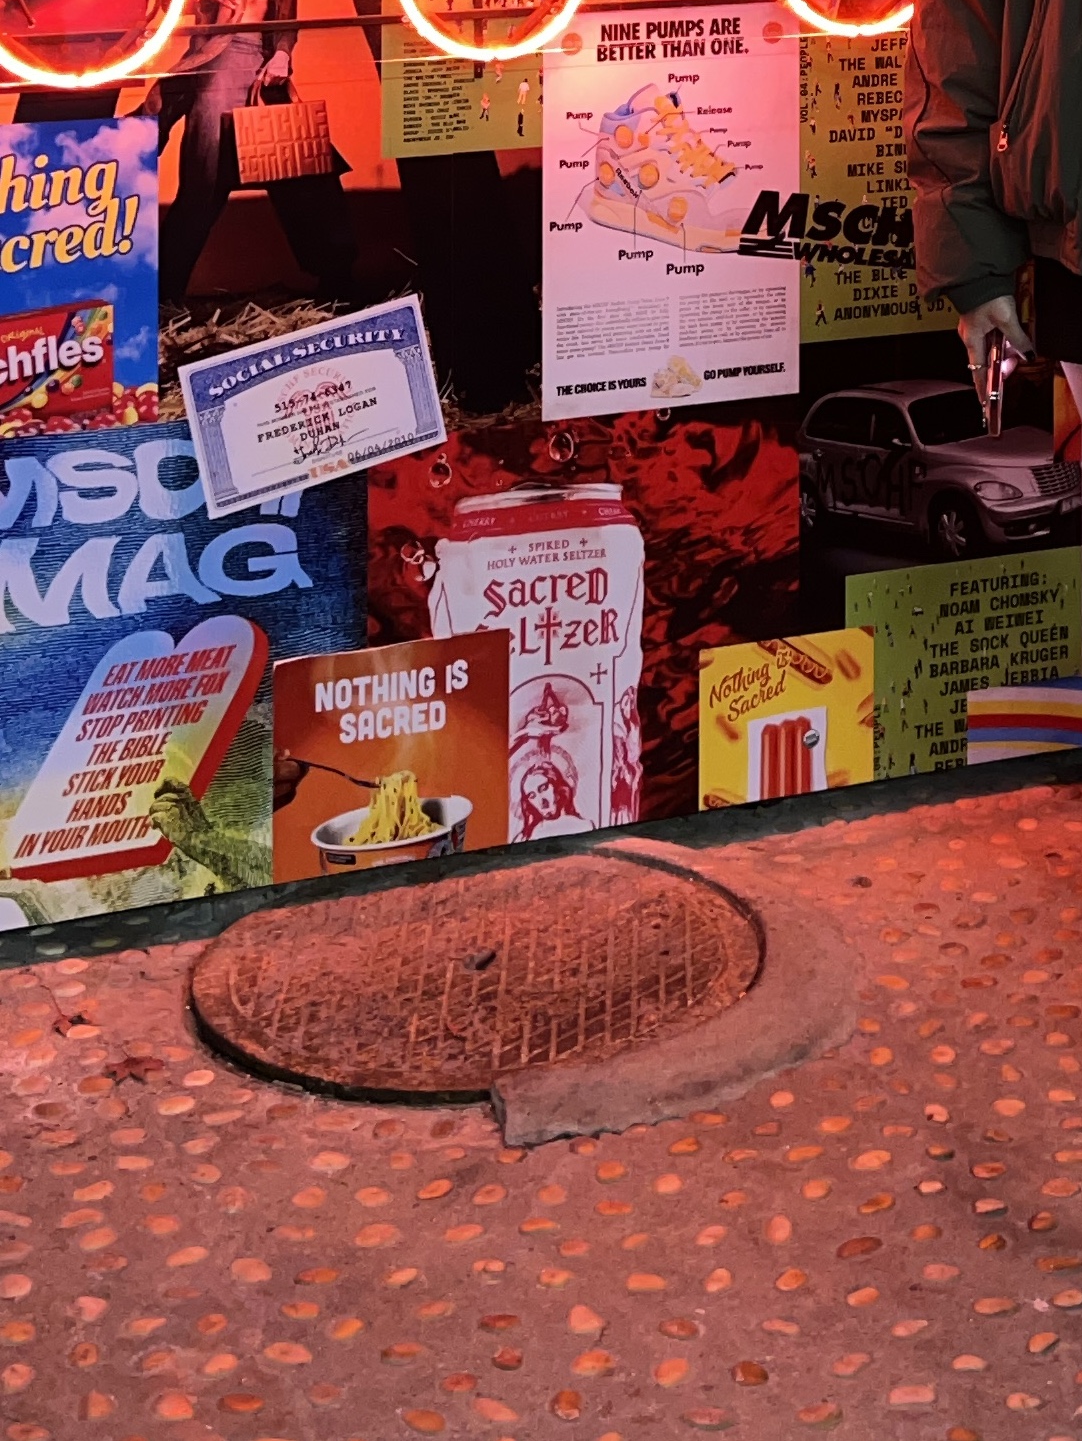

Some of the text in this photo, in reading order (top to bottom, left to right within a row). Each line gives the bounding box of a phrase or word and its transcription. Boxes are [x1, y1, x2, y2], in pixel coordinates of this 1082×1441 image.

[601, 17, 741, 42] NINE PUMPS ARE
[597, 36, 749, 62] BETTER THAN ONE.
[839, 55, 905, 71] THE WAL
[668, 73, 700, 83] Pump
[852, 73, 897, 88] ANDRE
[857, 90, 902, 105] REBEC
[566, 110, 593, 121] Pump
[829, 127, 875, 143] DAVID
[559, 159, 590, 169] Pump
[848, 162, 885, 177] MIKE
[549, 221, 583, 232] Pump
[741, 190, 914, 247] MSCH
[618, 249, 654, 261] Pump
[666, 263, 704, 276] Pump
[834, 270, 862, 285] THE
[853, 285, 898, 301] DIXIE
[208, 328, 405, 398] SOCIAL SECURITY
[703, 369, 717, 380] GO
[717, 366, 741, 378] PUMP
[556, 377, 647, 396] THE CHOICE IS YOURS
[257, 413, 330, 443] FREDERICK
[338, 397, 378, 417] LOGAN
[308, 461, 349, 478] USA
[528, 539, 570, 552] SPIKED
[487, 548, 607, 571] HOLY WATER SELTZER
[950, 572, 1048, 597] FEATURING:
[939, 599, 980, 618] NOAM
[955, 610, 1044, 635] AI WEIWEI
[930, 641, 959, 658] THE
[970, 634, 1009, 653] SOCK
[103, 644, 238, 687] EAT MORE MEAT
[929, 645, 1069, 678] BARBARA KRUGER
[82, 670, 231, 716] WATCH MORE FOX
[314, 659, 469, 713] NOTHING IS
[709, 663, 771, 708] Nothing
[727, 670, 786, 722] Sacred
[939, 676, 990, 697] JAMES
[76, 699, 209, 742] STOP PRINTING
[339, 700, 447, 744] SACRED
[914, 722, 944, 739] THE
[87, 731, 172, 766] THE BIBLE
[929, 738, 968, 757] ANDR
[62, 759, 166, 797] STICK YOUR
[66, 791, 132, 823] HANDS
[14, 814, 152, 859] IN YOUR MOUTH
